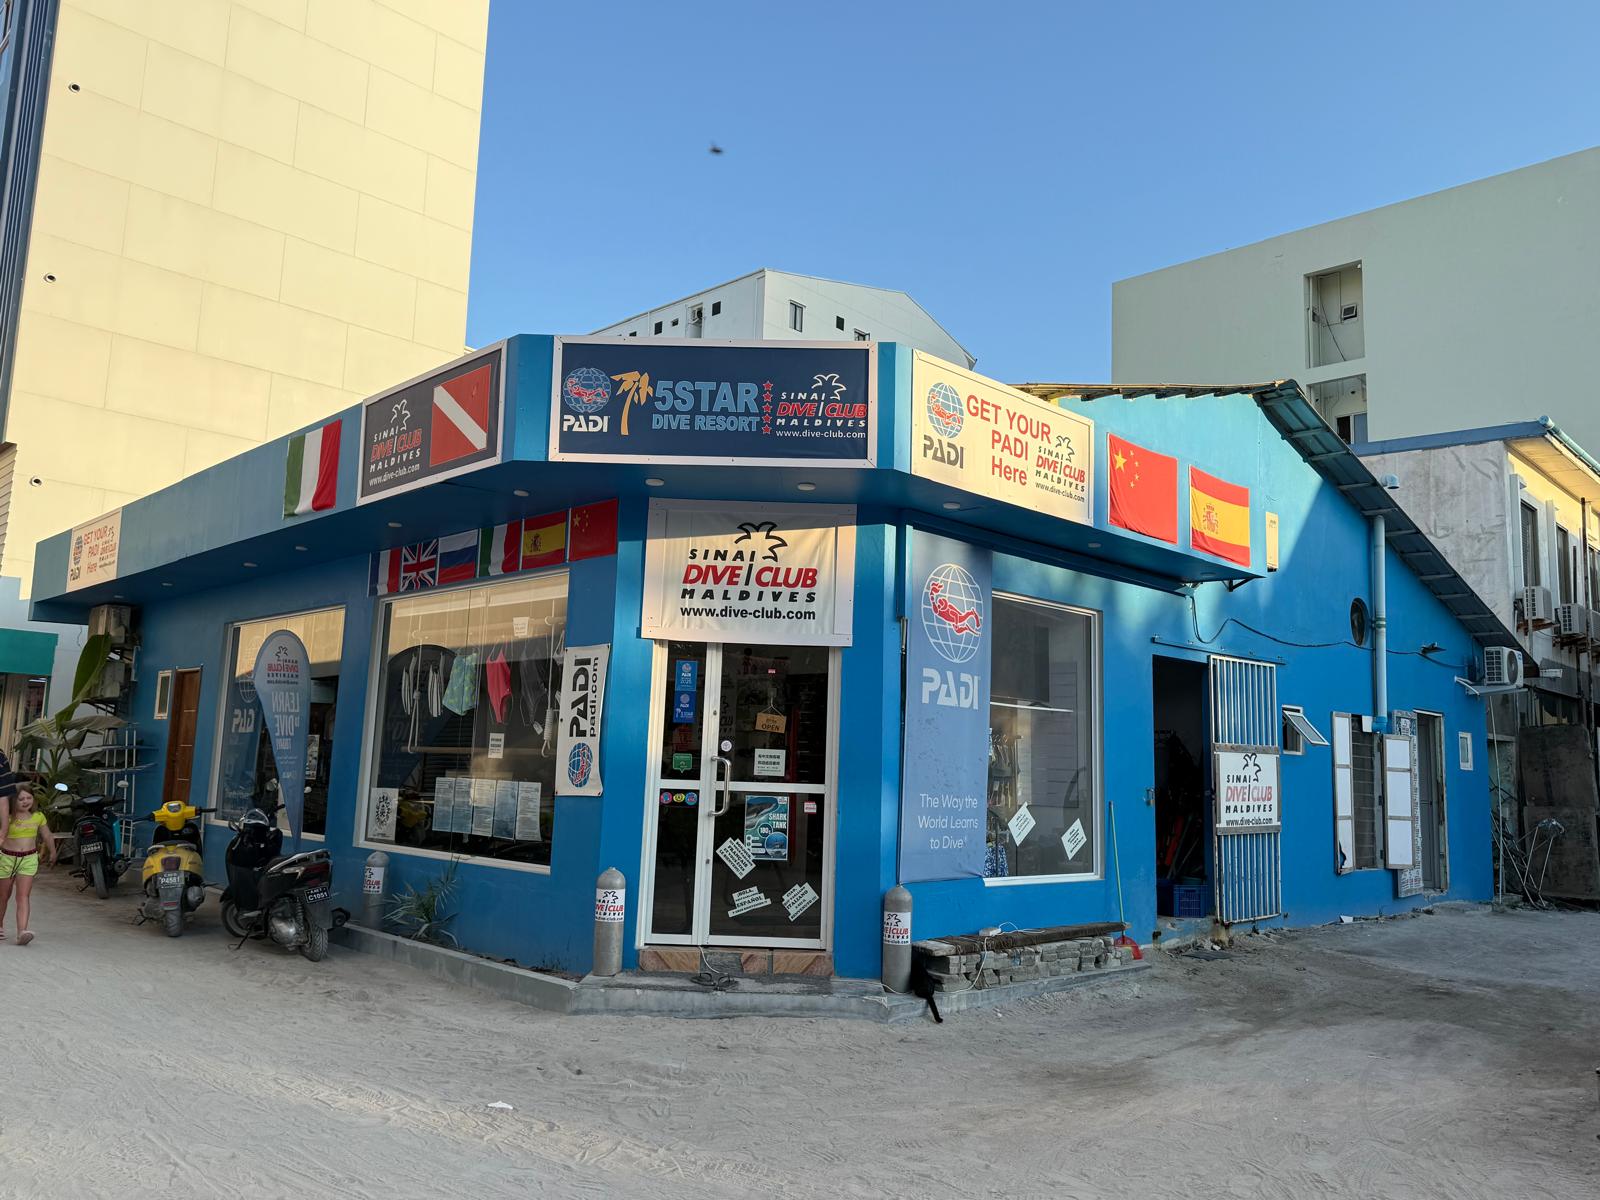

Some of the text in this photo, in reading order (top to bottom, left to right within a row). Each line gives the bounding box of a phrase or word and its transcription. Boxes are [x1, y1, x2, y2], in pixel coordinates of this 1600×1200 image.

[780, 392, 824, 401] SINAI
[776, 402, 868, 418] DIVE CLUB
[966, 394, 1051, 444] GET YOUR
[563, 414, 609, 433] PADI
[652, 414, 760, 432] DIVE RESORT
[776, 418, 866, 428] MALDIVES
[373, 426, 398, 442] SINAI
[776, 429, 866, 439] www.dive-club.com
[371, 428, 422, 462] DIVE CLUB
[924, 434, 964, 469] PADI
[991, 429, 1028, 460] PADI
[1038, 446, 1064, 460] SINAI
[369, 448, 422, 473] MALDIVES
[1036, 454, 1086, 483] DIVE CLUB
[368, 464, 420, 487] www.dive-club.com
[992, 455, 1028, 486] Here
[1035, 469, 1085, 492] MALDIVES
[1035, 481, 1085, 502] www.dive-club.com
[688, 548, 756, 562] SINAI
[682, 564, 818, 588] DIVE CLUB
[681, 588, 816, 603] MALDIVES
[680, 606, 816, 620] www.dive-club.com
[569, 658, 591, 737] PADI
[590, 657, 599, 737] padi.com
[921, 668, 979, 711] PADI
[1226, 774, 1251, 783] SINAI
[920, 793, 977, 811] The Way the
[1226, 786, 1272, 801] DIVE CLUB
[1225, 804, 1273, 813] MALDIVES
[918, 815, 978, 830] World Learns
[1226, 816, 1273, 826] www.dive-club.com
[929, 835, 964, 849] to Dive
[308, 892, 328, 900] C1051
